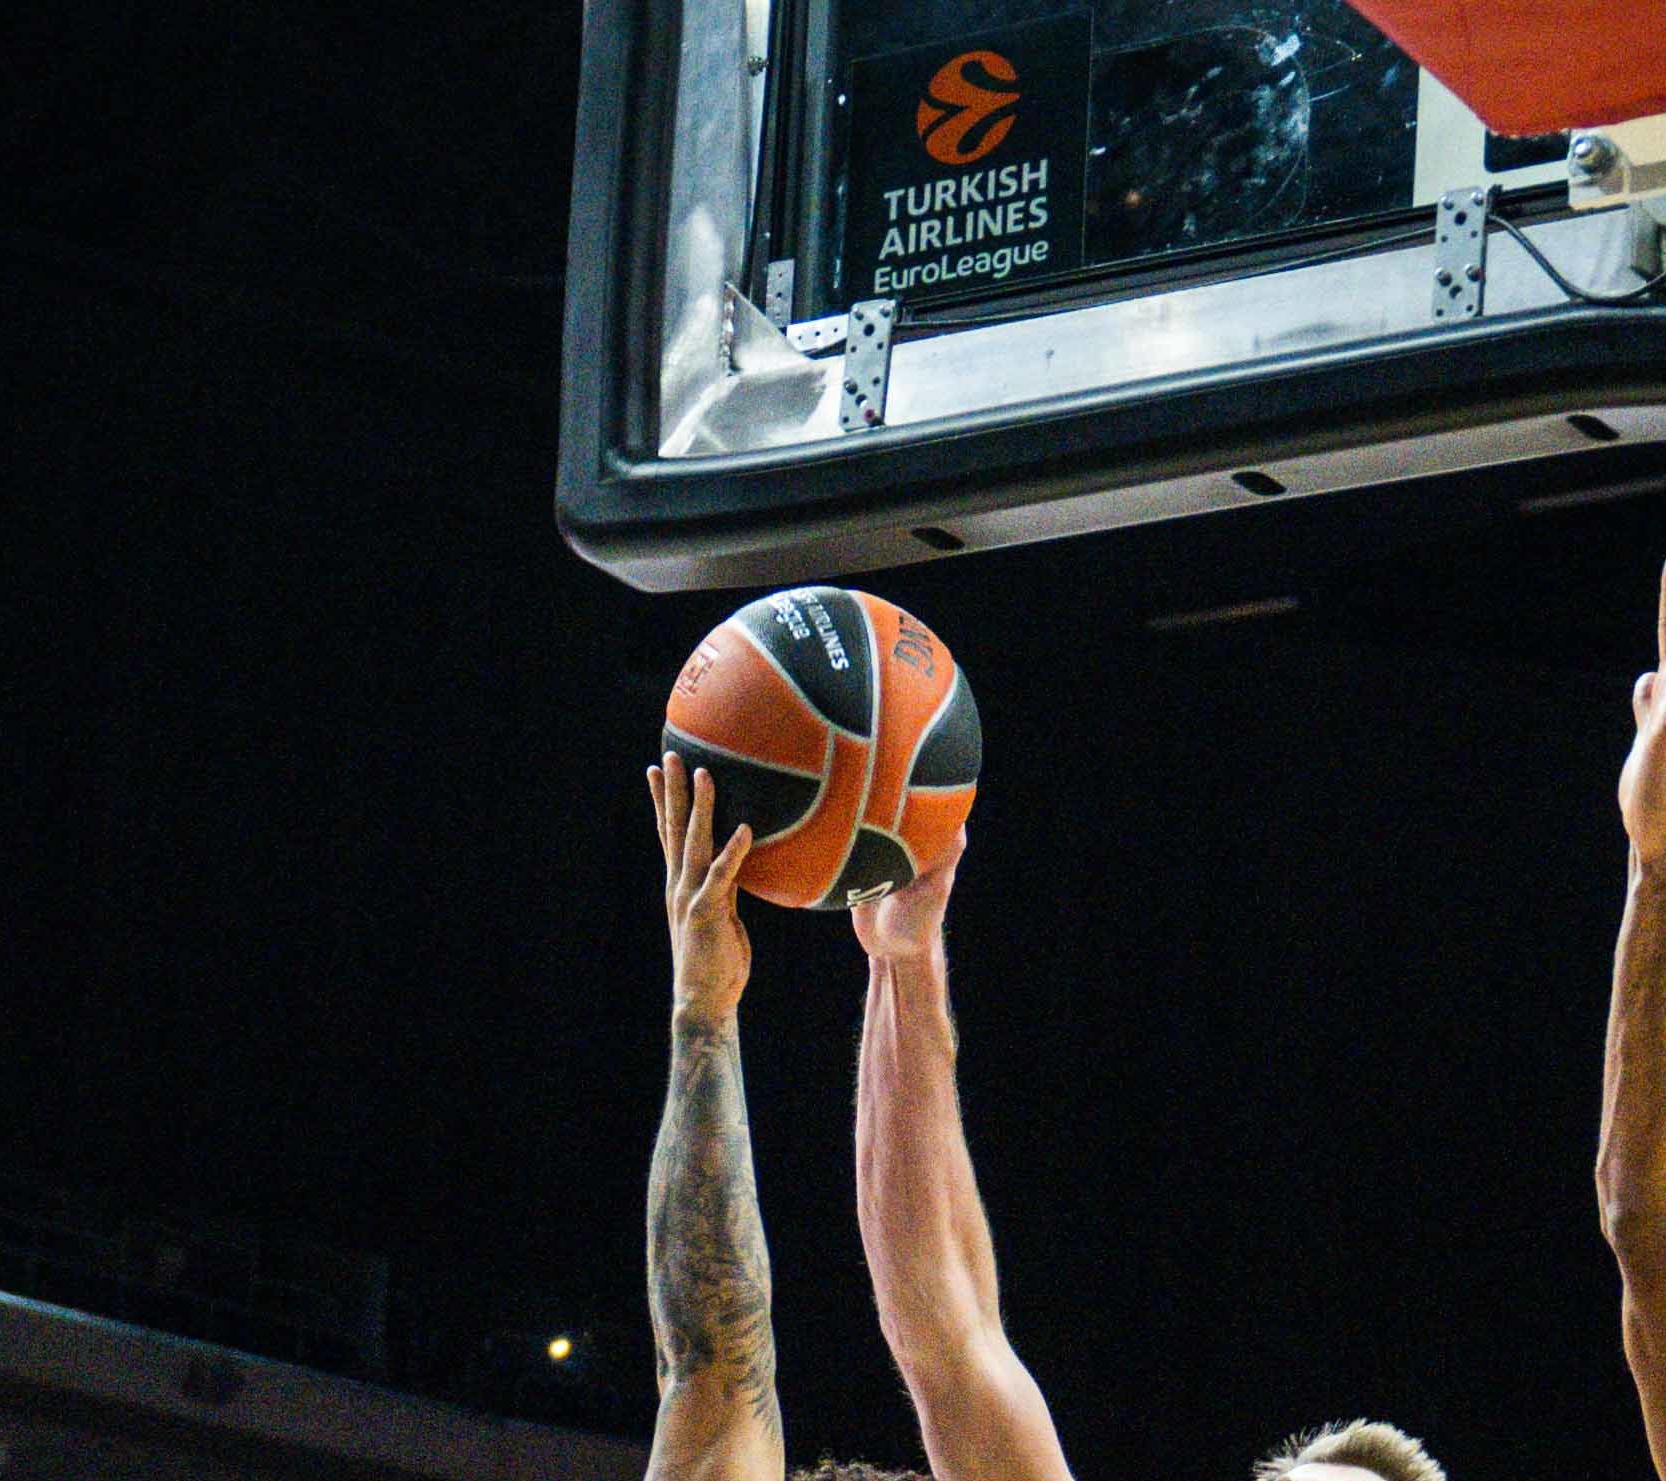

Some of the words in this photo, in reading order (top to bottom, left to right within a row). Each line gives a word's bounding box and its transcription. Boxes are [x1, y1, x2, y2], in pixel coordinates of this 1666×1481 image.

[883, 158, 1048, 222] TURKISH
[877, 196, 1048, 260] AIRLINES
[874, 240, 1049, 294] EuroLeague
